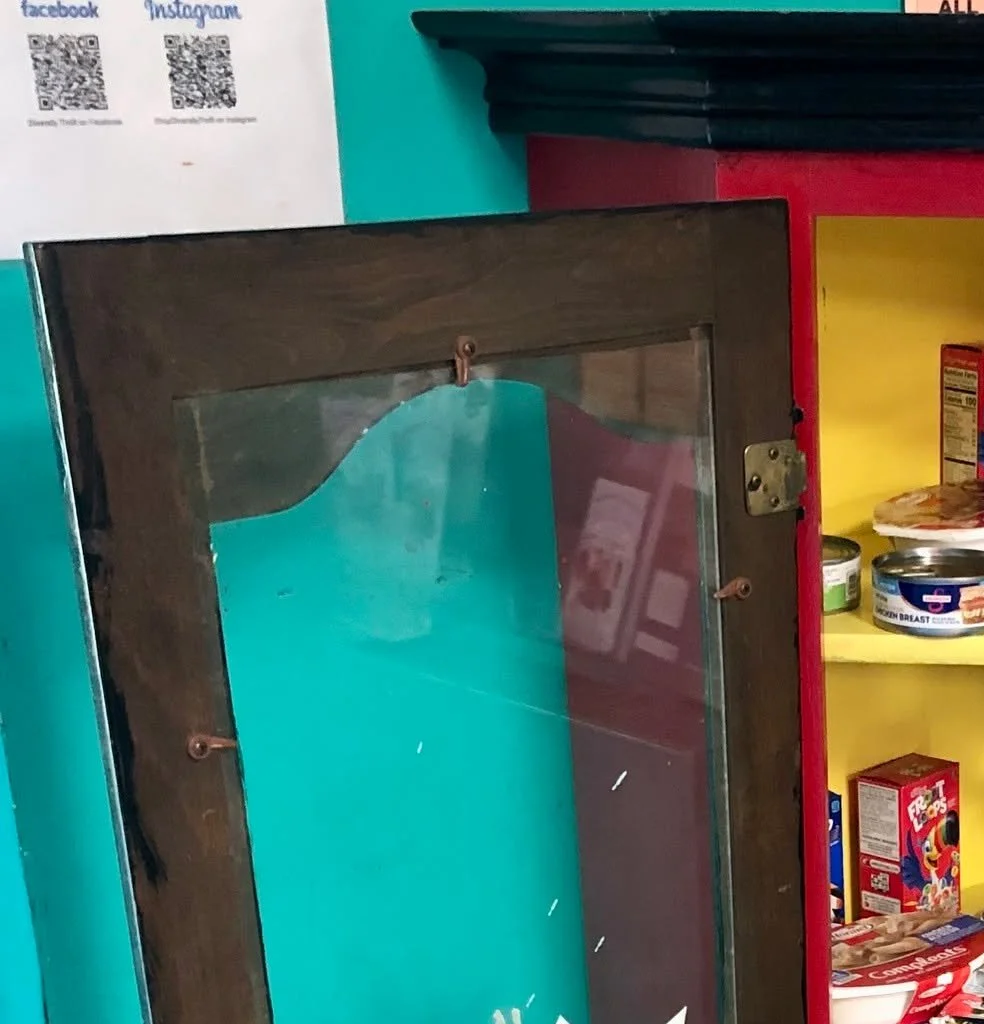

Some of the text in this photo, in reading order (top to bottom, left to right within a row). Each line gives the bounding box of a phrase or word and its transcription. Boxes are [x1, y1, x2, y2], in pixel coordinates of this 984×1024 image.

[20, 0, 99, 18] facebook
[144, 0, 242, 29] Instagram
[939, 0, 978, 14] ALL
[899, 613, 930, 624] BREAST
[912, 797, 947, 832] LOOPS
[868, 944, 967, 980] Compleats
